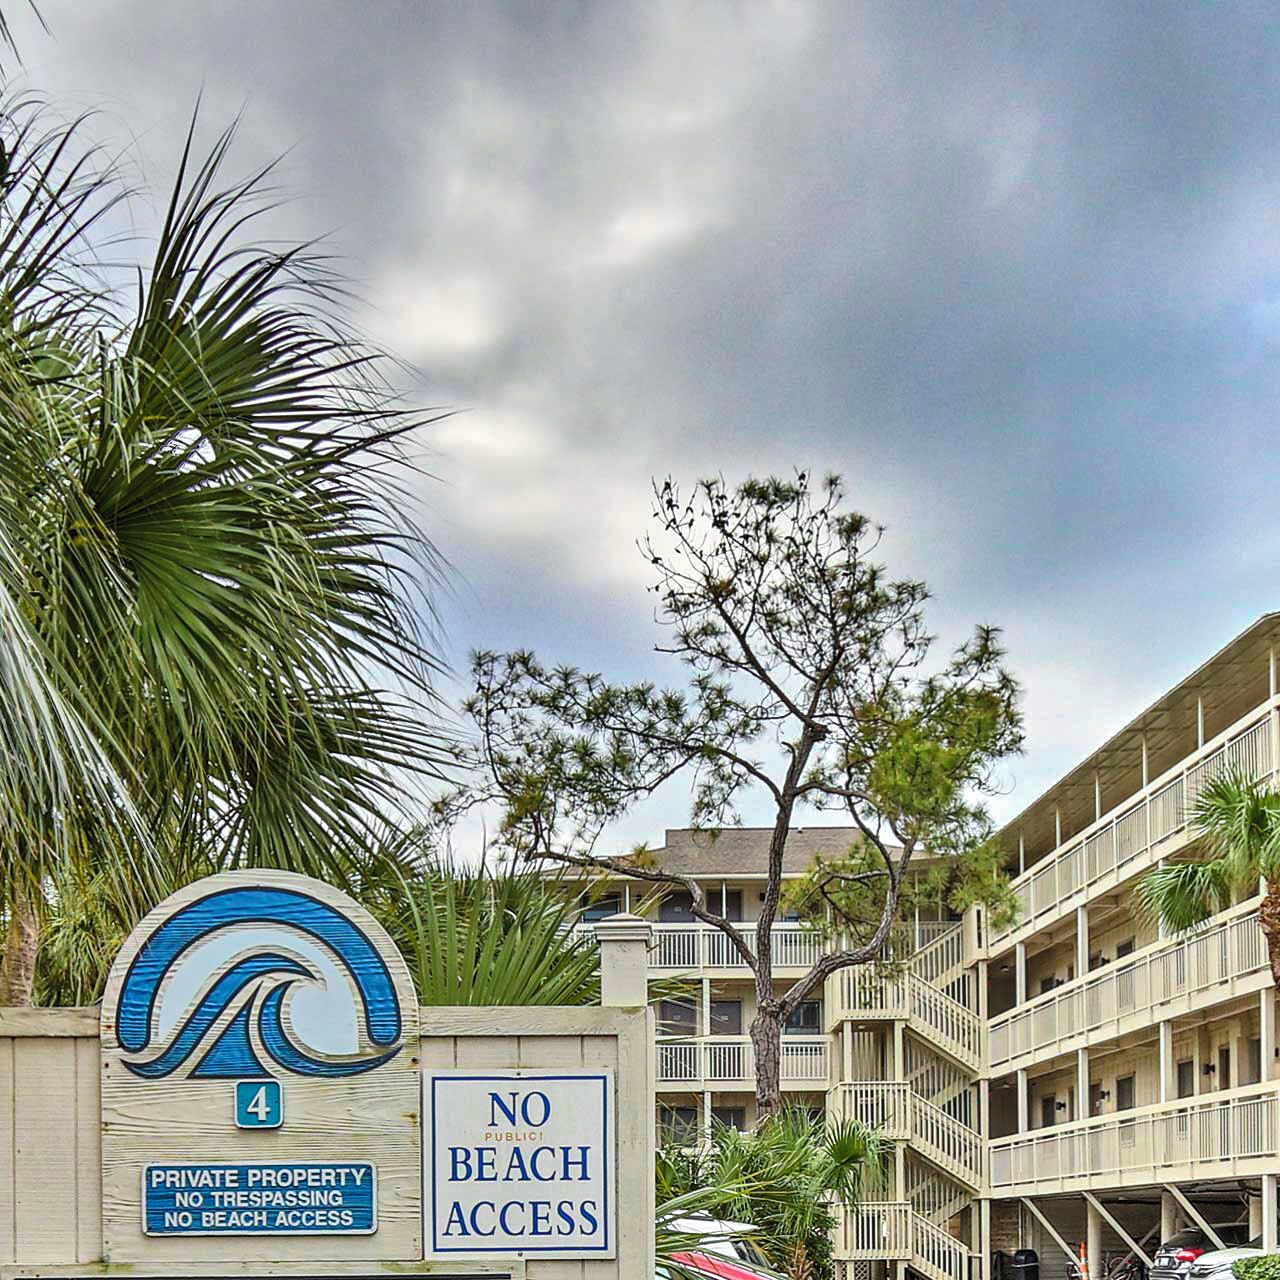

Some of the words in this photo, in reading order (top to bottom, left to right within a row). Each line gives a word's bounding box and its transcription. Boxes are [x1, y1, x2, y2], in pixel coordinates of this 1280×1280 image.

[247, 1086, 271, 1121] 4
[488, 1091, 552, 1128] NO
[151, 1170, 238, 1188] PRIVATE
[248, 1168, 366, 1187] PROPERTY
[448, 1146, 592, 1182] BEACH
[175, 1192, 204, 1207] NO
[211, 1190, 343, 1206] TRESPASSING
[164, 1212, 193, 1227] NO
[201, 1211, 267, 1227] BEACH
[274, 1210, 354, 1226] ACCESS
[442, 1200, 599, 1237] ACCESS
